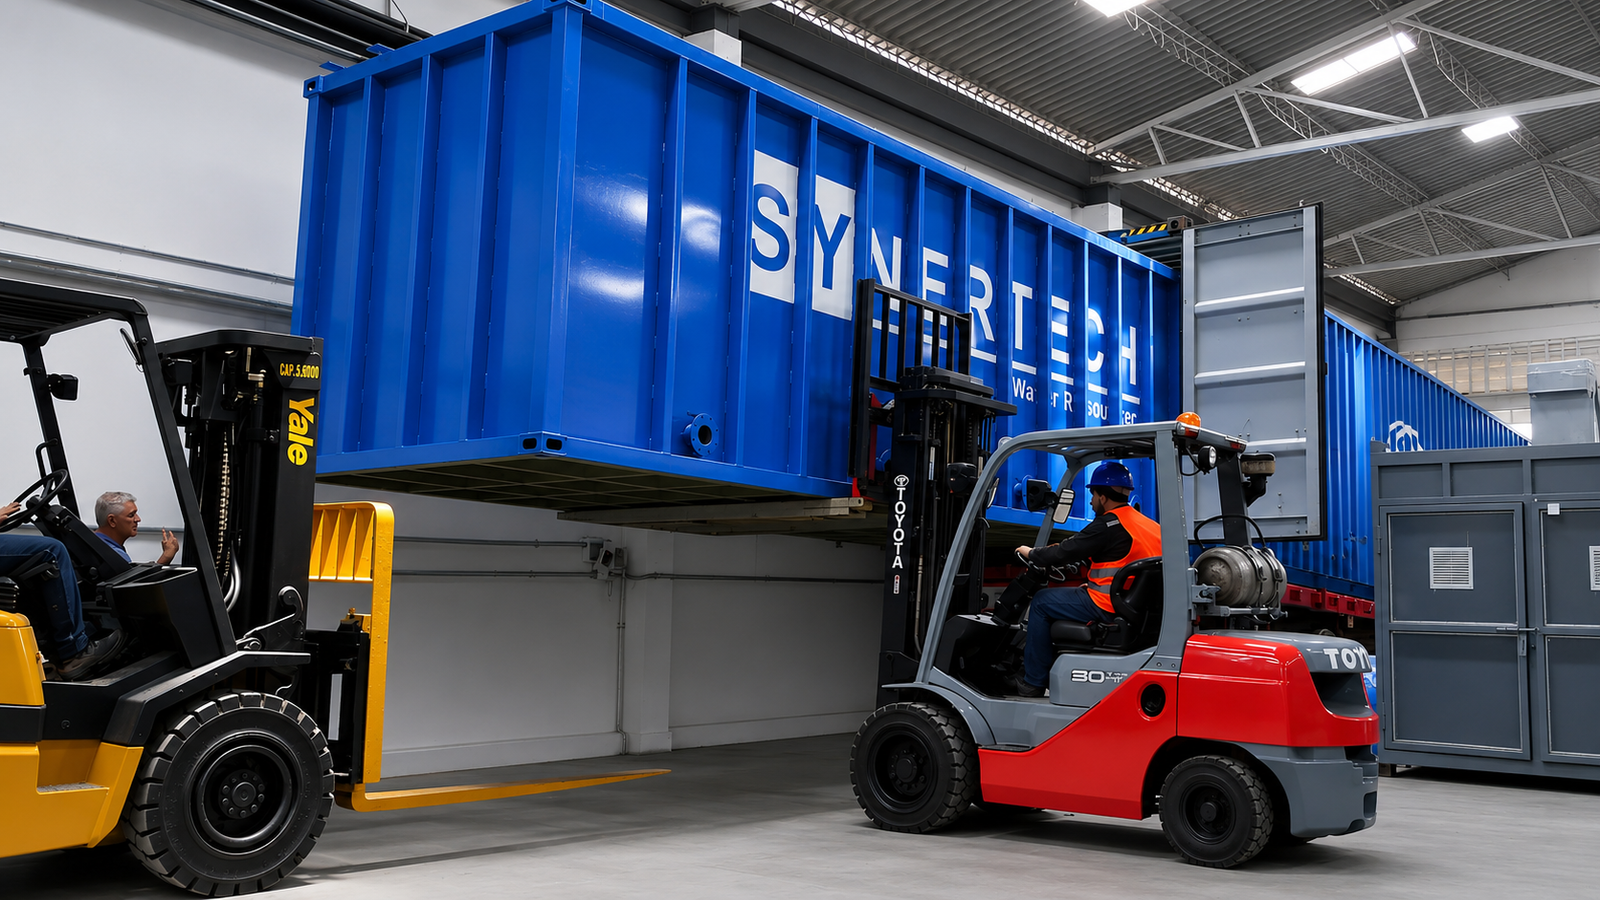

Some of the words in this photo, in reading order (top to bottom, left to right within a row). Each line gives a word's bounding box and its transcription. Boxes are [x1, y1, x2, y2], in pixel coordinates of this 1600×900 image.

[1011, 376, 1060, 408] War
[287, 397, 315, 466] Yale
[892, 487, 907, 569] TOYOTA
[1071, 669, 1105, 684] 30
